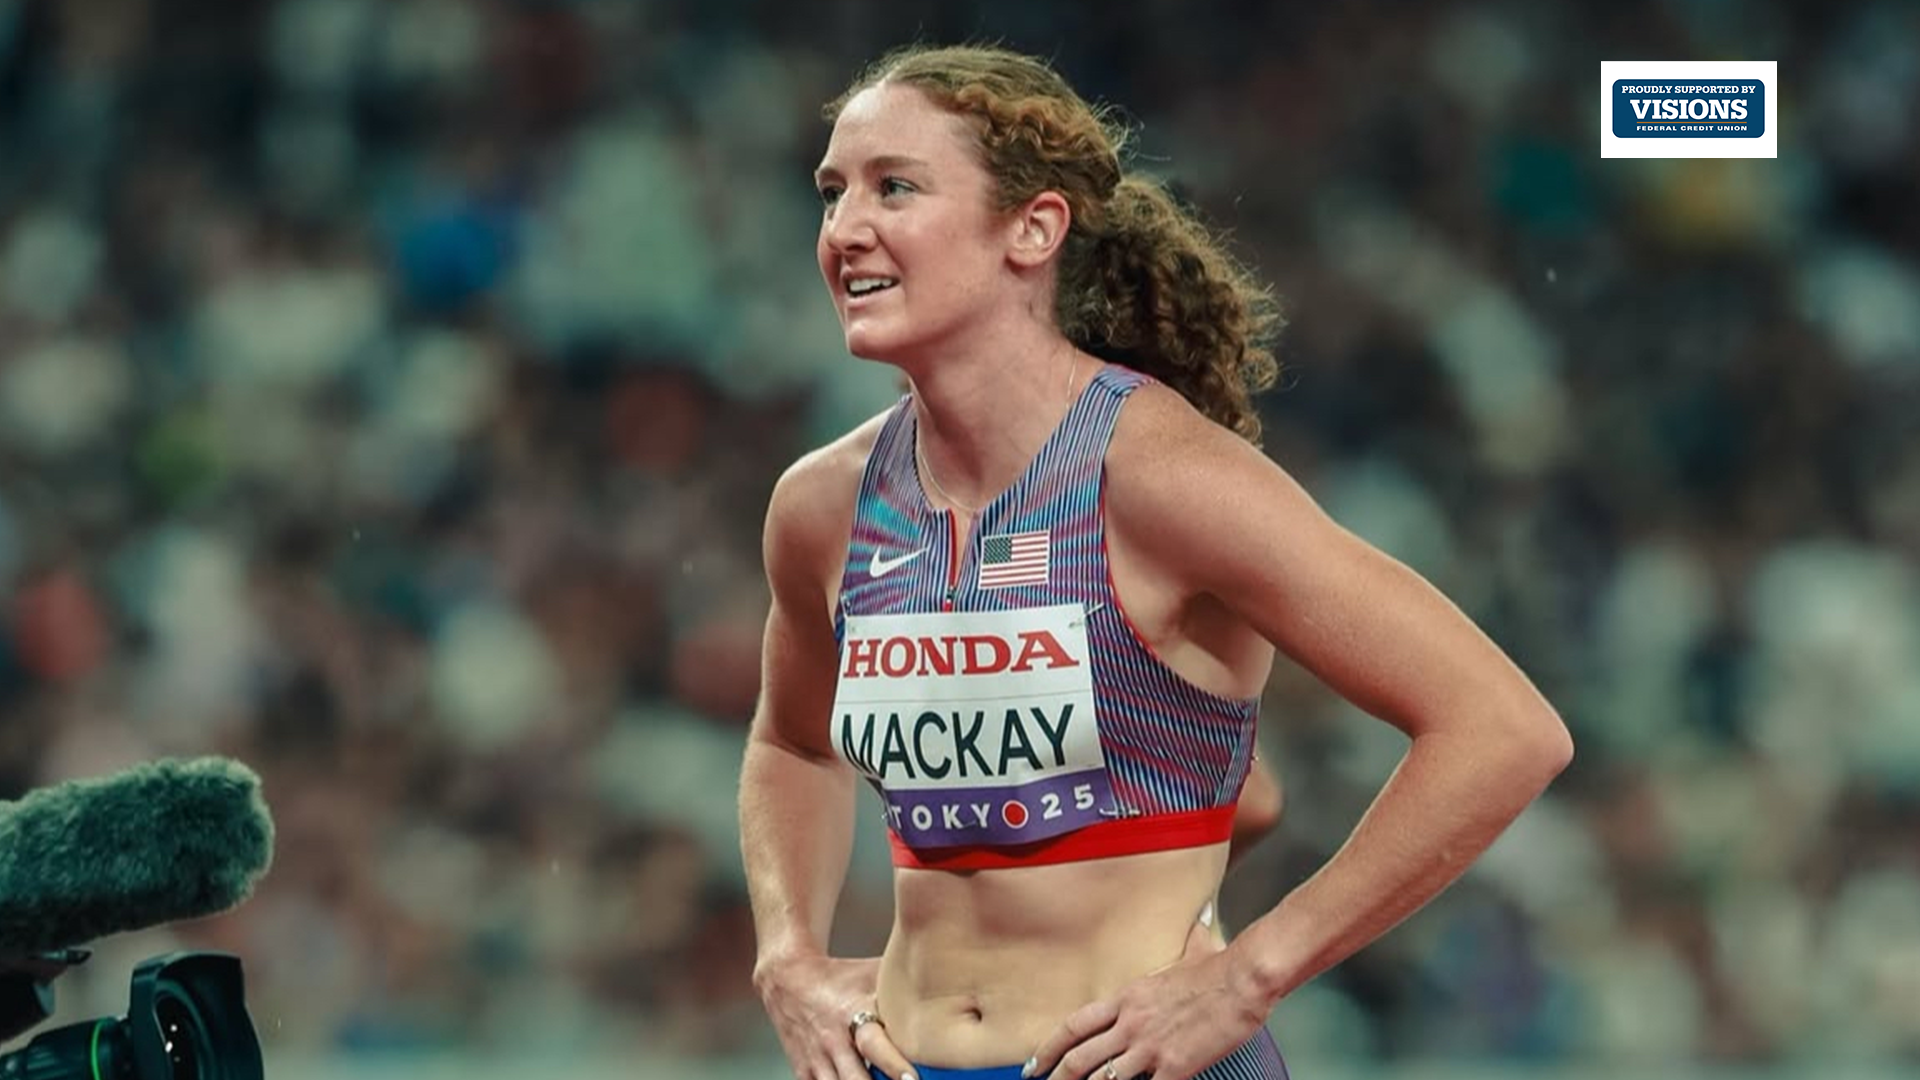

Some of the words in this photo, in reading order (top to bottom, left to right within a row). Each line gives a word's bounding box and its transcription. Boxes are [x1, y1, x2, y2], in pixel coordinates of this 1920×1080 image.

[842, 630, 1080, 679] HONDA
[842, 704, 1075, 780] MACKAY
[1040, 784, 1095, 821] 25
